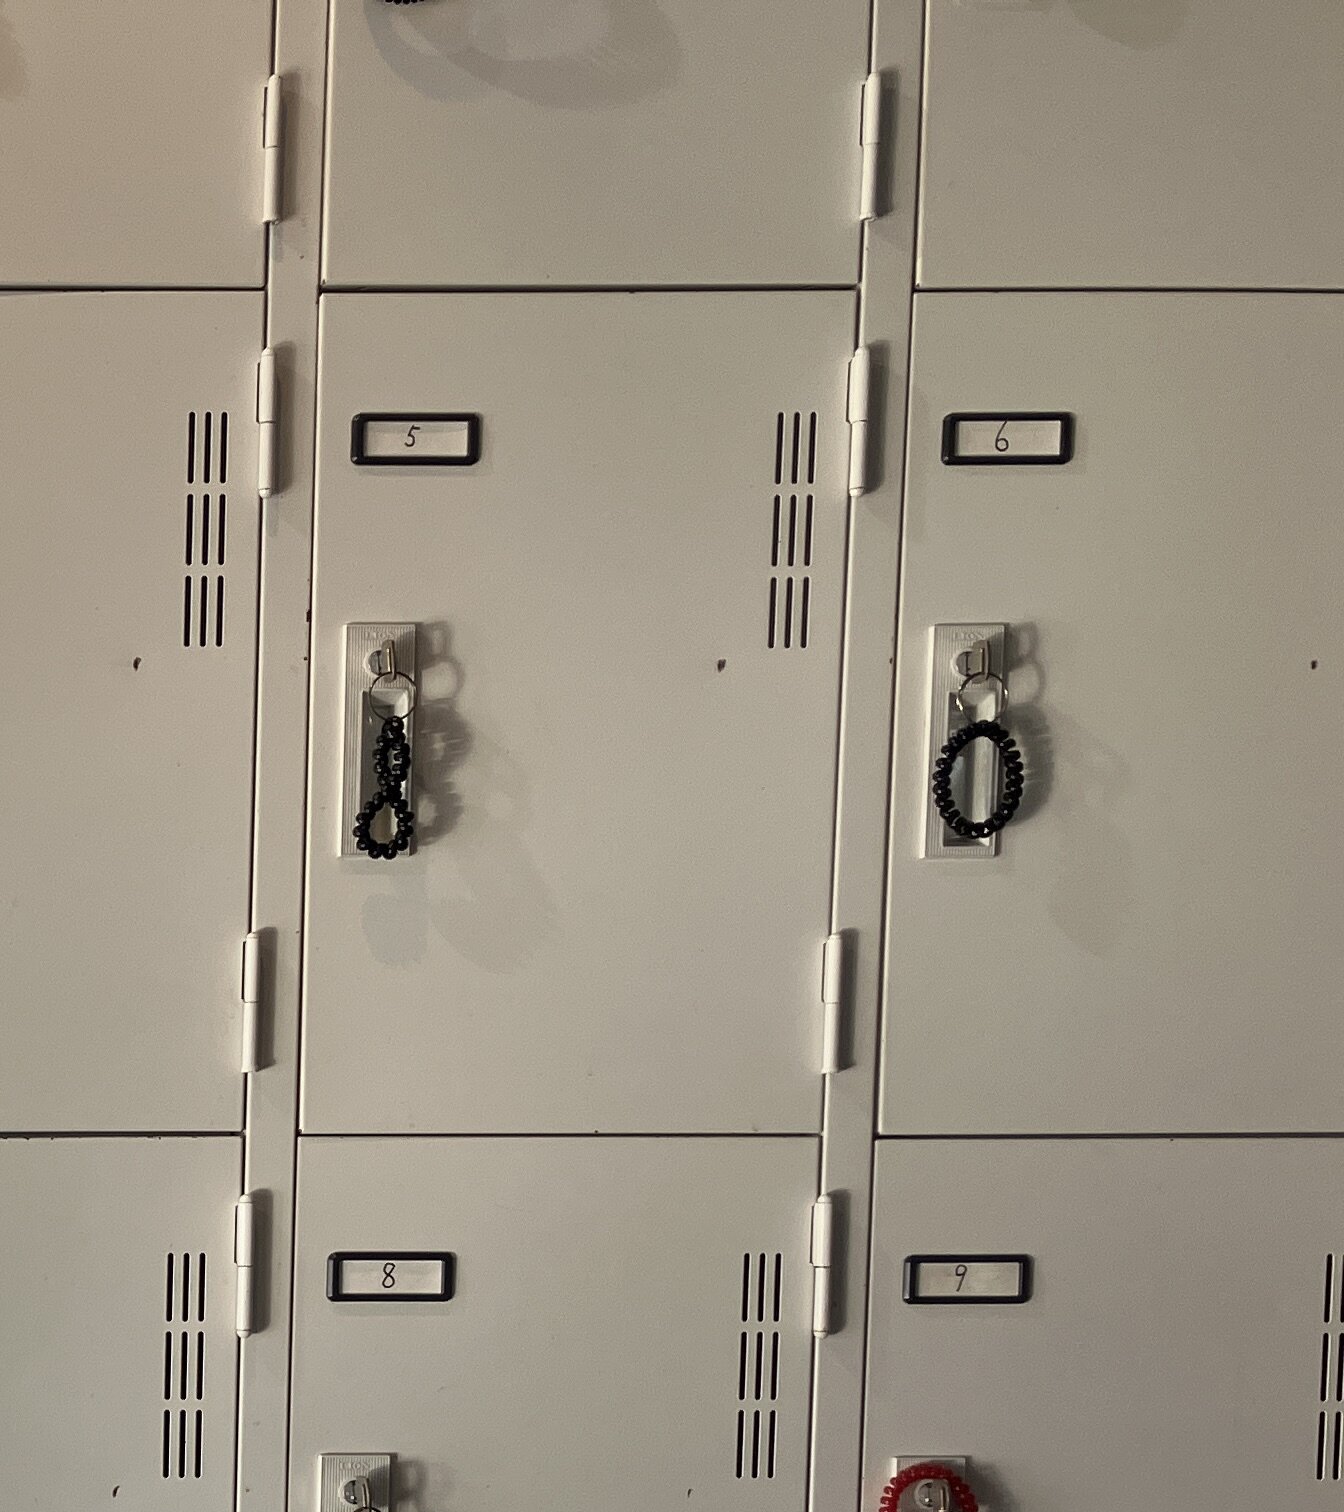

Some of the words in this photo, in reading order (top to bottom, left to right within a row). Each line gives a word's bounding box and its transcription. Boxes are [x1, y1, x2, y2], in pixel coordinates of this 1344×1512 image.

[404, 424, 421, 448] 5
[994, 420, 1010, 453] 6
[381, 1262, 397, 1289] 8
[954, 1263, 968, 1293] 9
